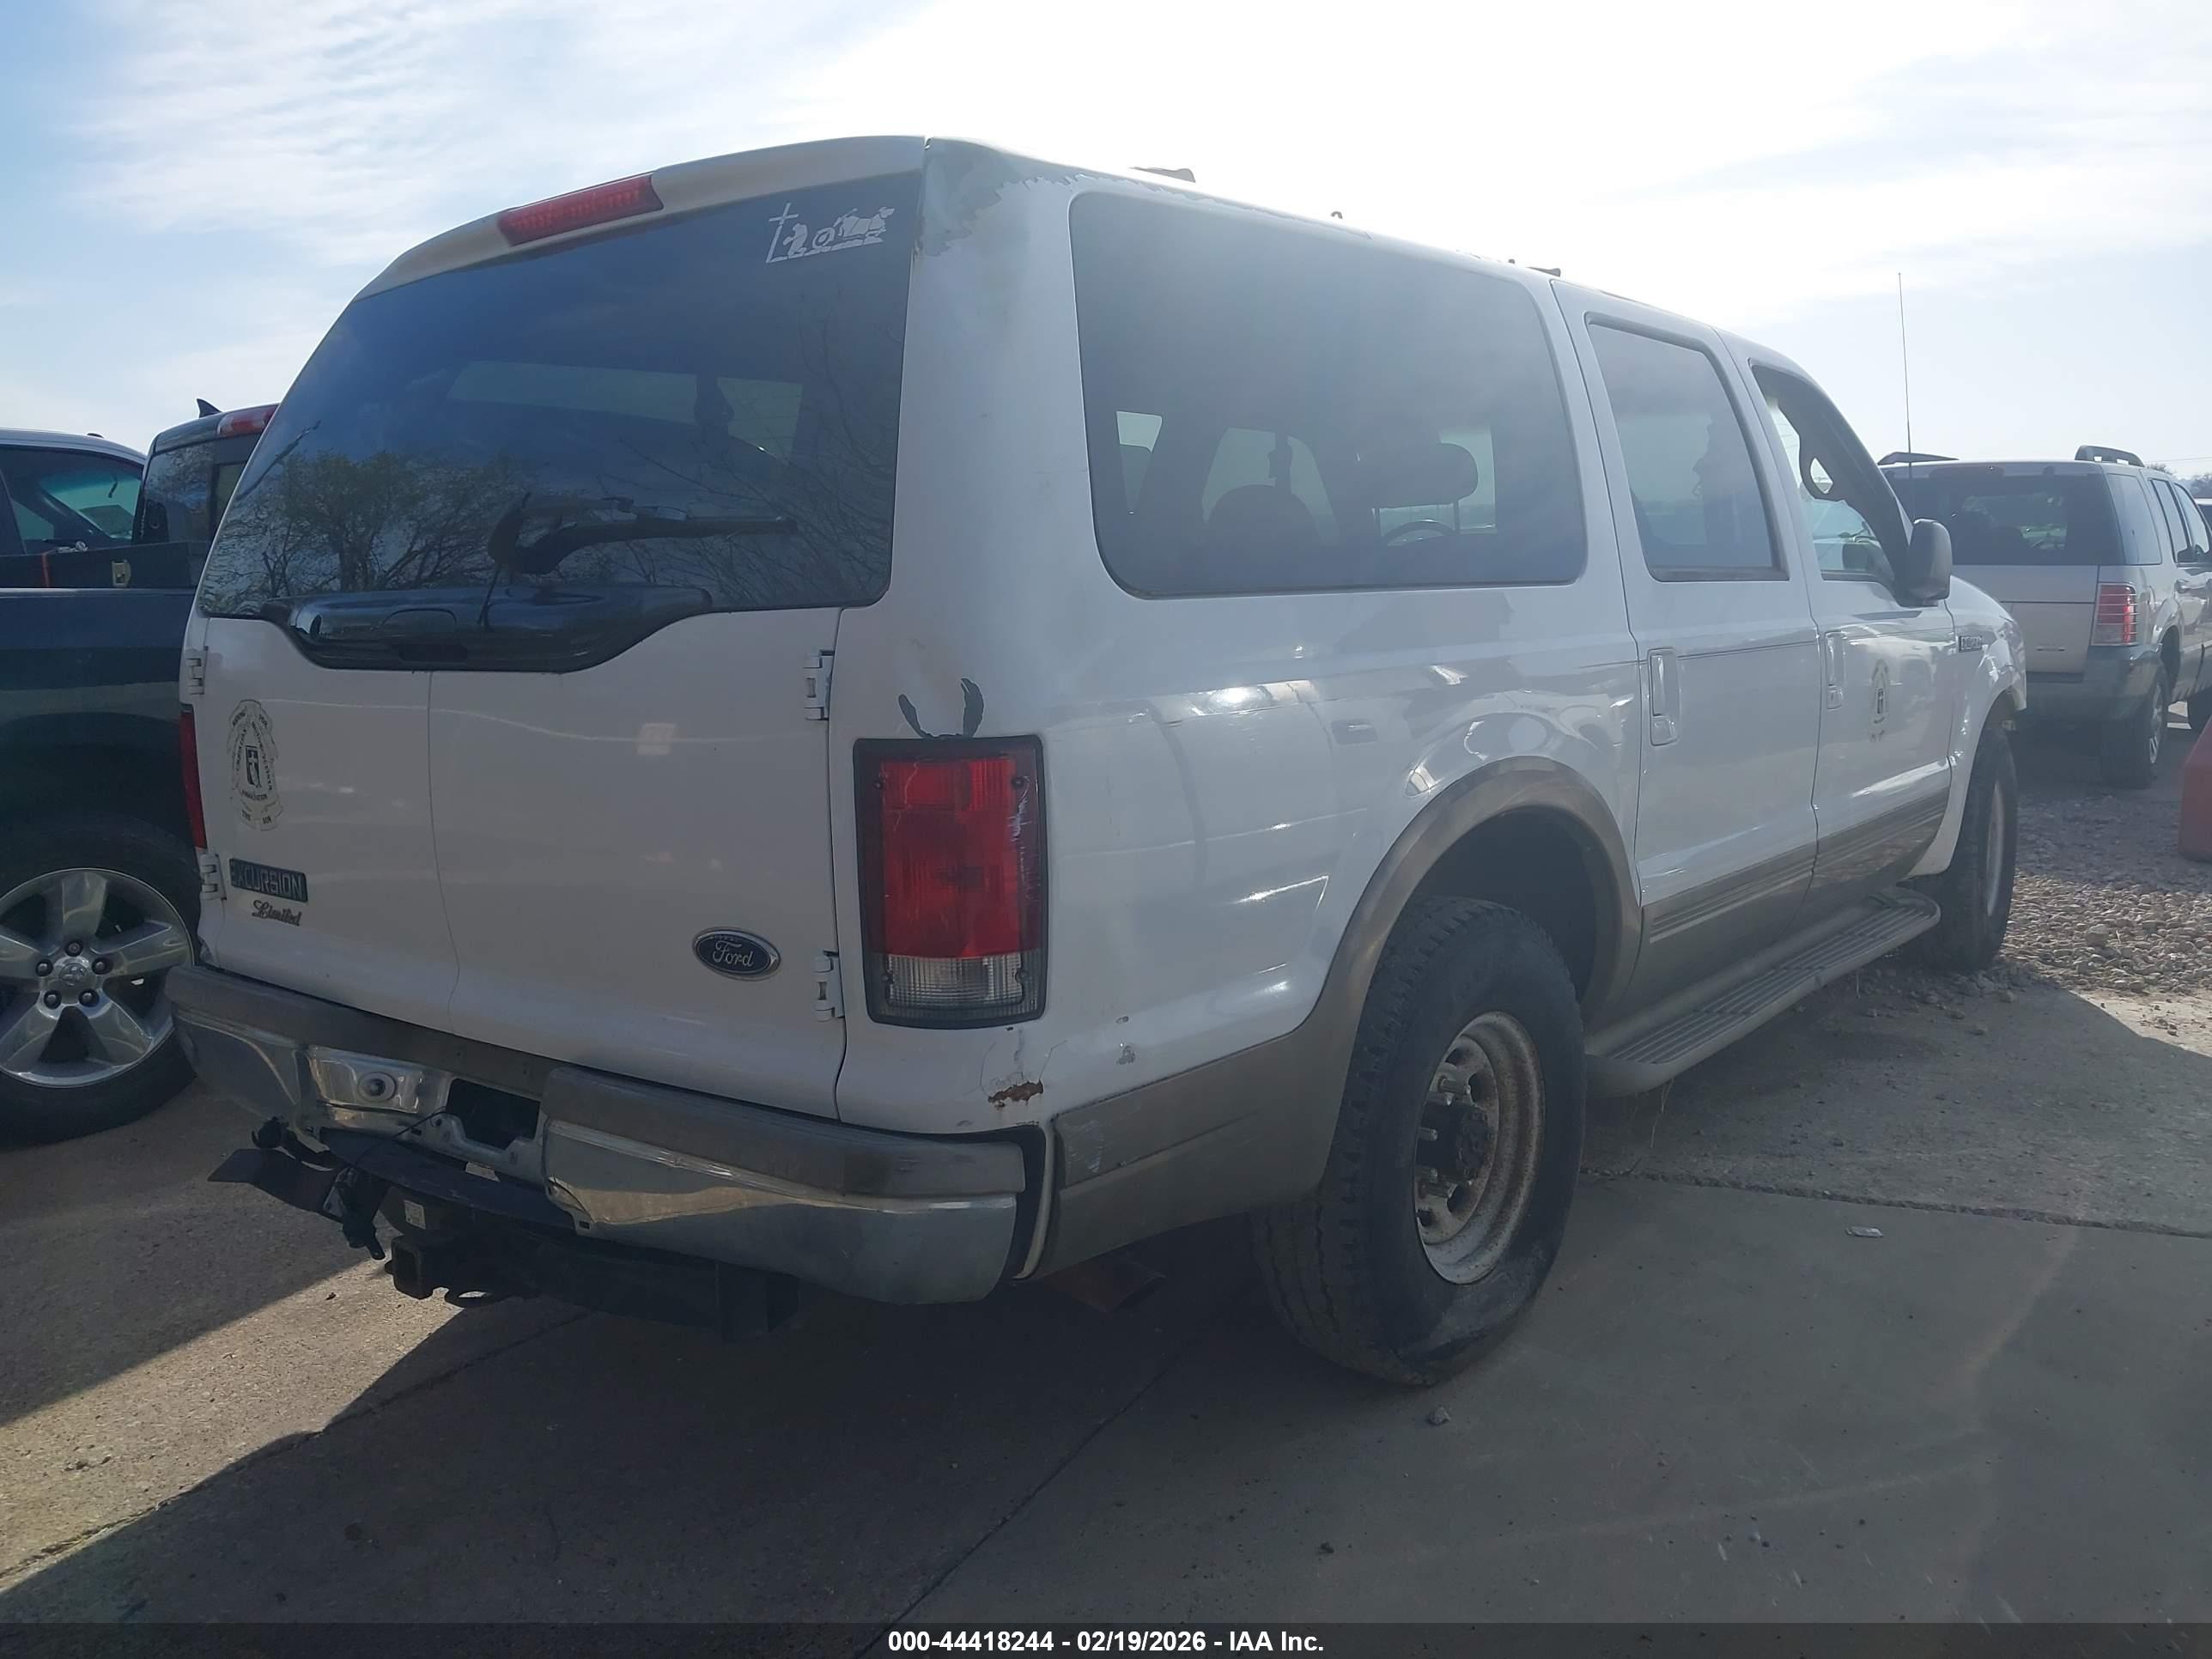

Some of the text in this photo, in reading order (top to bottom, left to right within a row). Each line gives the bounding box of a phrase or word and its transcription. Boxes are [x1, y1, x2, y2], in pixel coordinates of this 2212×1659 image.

[231, 862, 303, 900] EXCURSION
[252, 899, 303, 927] Limited
[712, 939, 754, 967] Ford
